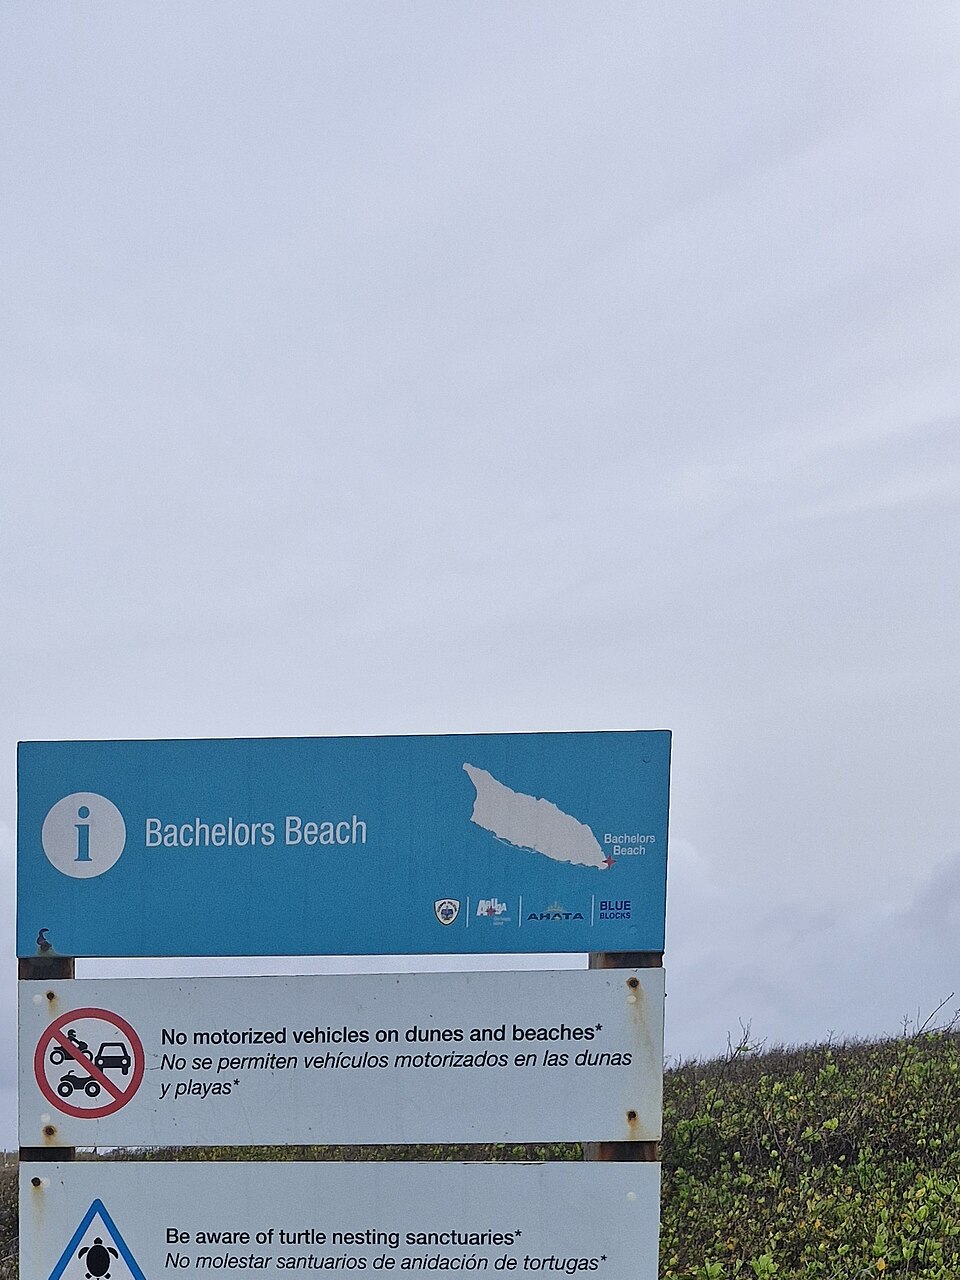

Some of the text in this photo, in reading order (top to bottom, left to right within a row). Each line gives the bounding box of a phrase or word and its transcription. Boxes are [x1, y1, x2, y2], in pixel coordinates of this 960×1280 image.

[145, 814, 367, 847] Bachelors Beach
[603, 833, 656, 844] Bachelors
[613, 845, 646, 856] Beach
[599, 900, 631, 911] BLUE
[599, 912, 631, 920] BLOCKS
[161, 1028, 187, 1046] No
[193, 1026, 287, 1045] motorized
[292, 1025, 370, 1044] vehicles
[375, 1029, 399, 1043] on
[404, 1025, 464, 1043] dunes
[469, 1024, 506, 1042] and
[160, 1048, 633, 1074] No se permiten vehículos motorizados en las dunas
[158, 1082, 171, 1100] y
[166, 1227, 190, 1244] Be
[195, 1231, 251, 1244] aware
[255, 1228, 275, 1245] of
[278, 1228, 327, 1245] turtle
[332, 1228, 400, 1249] nesting
[164, 1252, 190, 1269] No
[195, 1252, 273, 1269] molestar
[275, 1252, 368, 1270] santuarios
[372, 1253, 396, 1270] de
[400, 1253, 488, 1270] anidación
[493, 1253, 517, 1271] de
